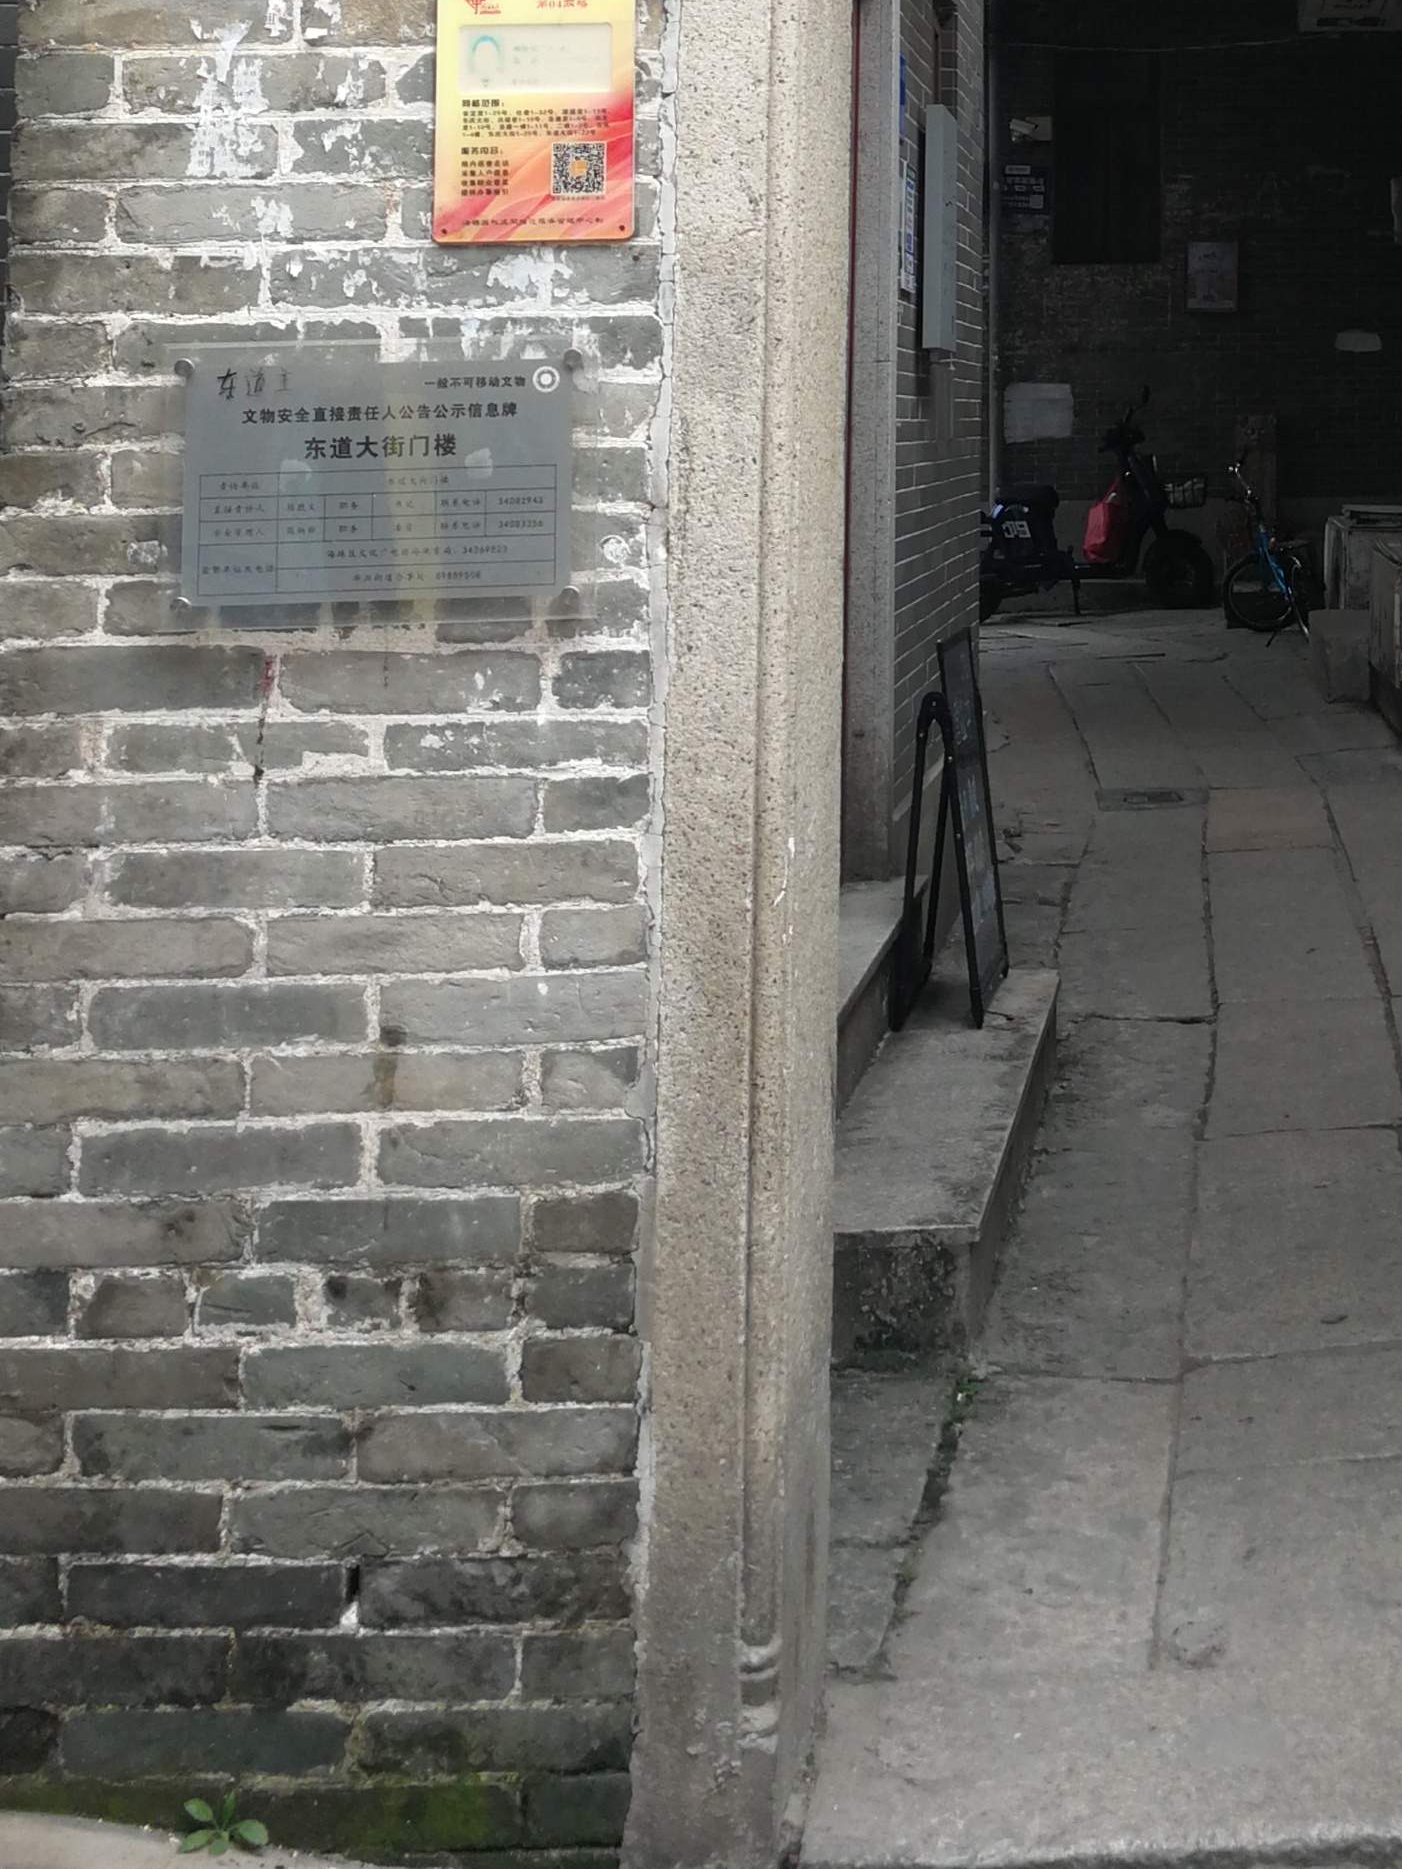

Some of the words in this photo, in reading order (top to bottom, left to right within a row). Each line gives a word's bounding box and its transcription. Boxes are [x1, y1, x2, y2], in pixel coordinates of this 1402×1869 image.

[424, 375, 526, 390] 一般不可移动文物
[242, 401, 518, 425] 文物安全直接责任人公告公示信息牌
[304, 432, 457, 461] 东道大街门楼
